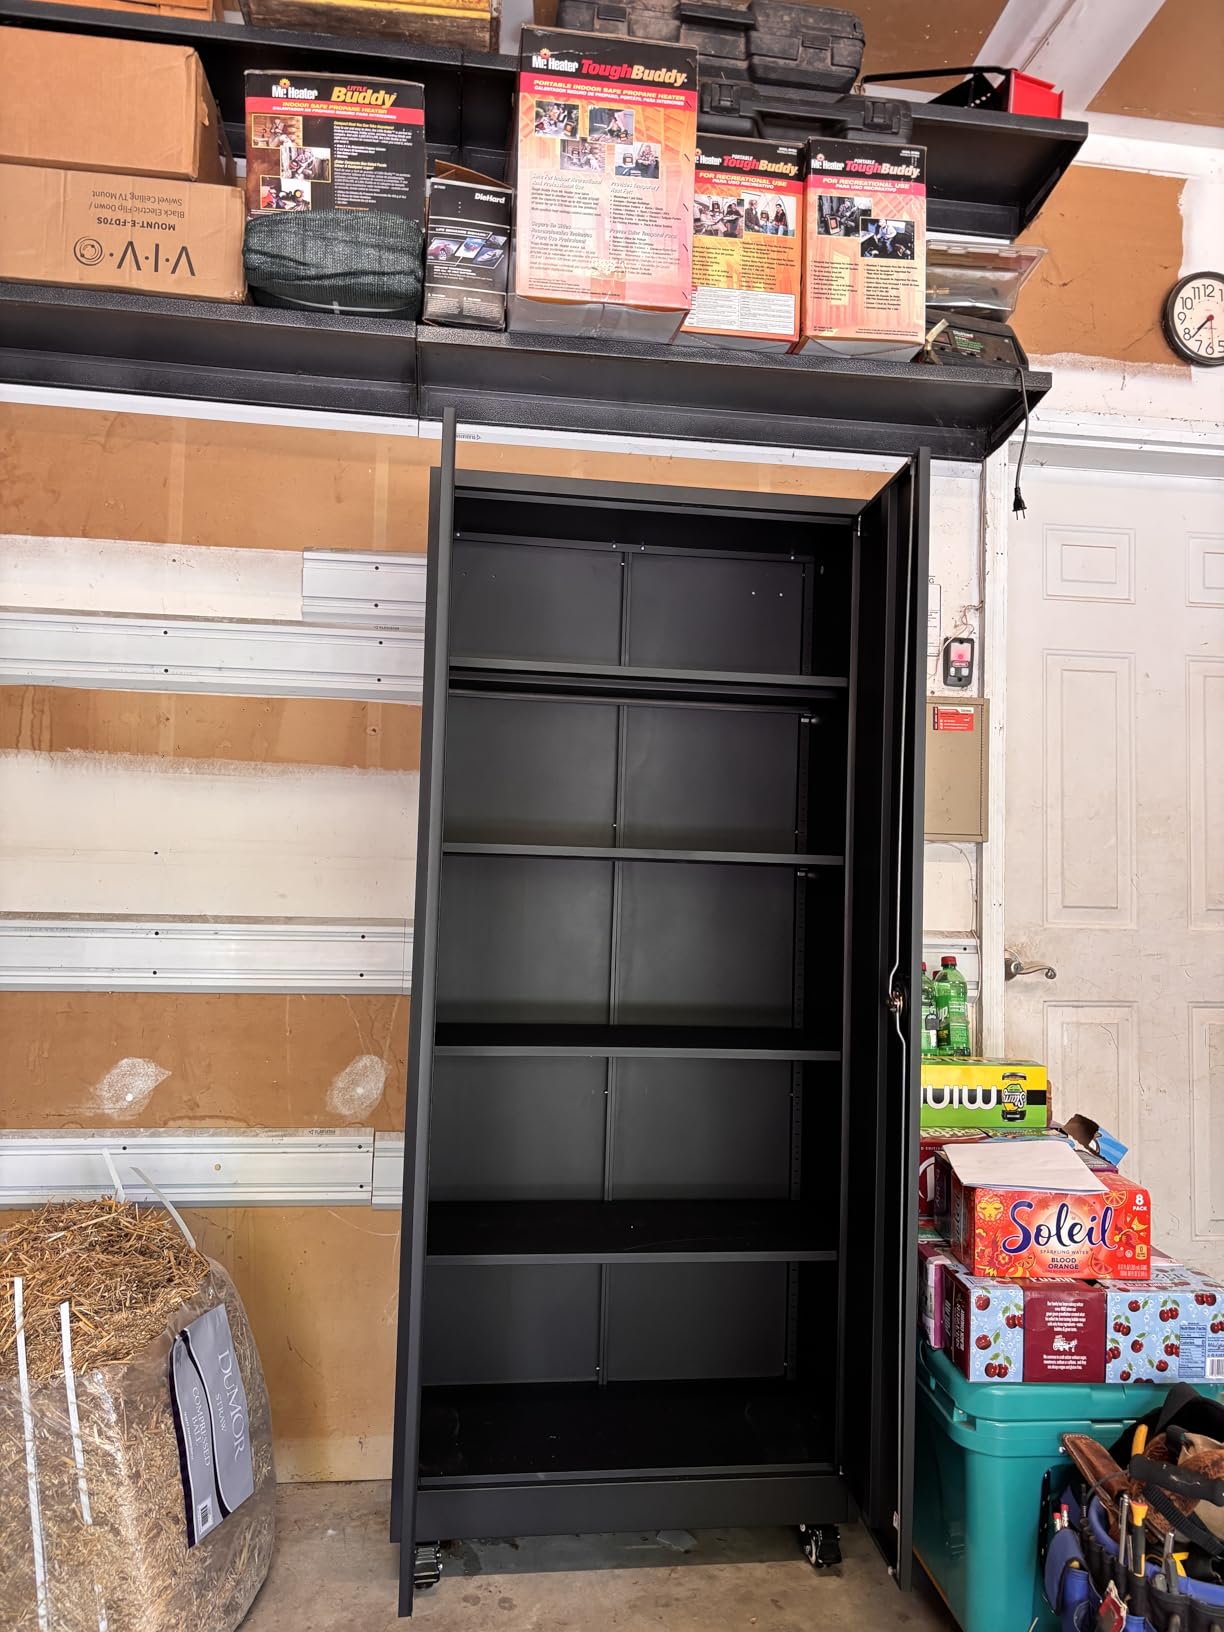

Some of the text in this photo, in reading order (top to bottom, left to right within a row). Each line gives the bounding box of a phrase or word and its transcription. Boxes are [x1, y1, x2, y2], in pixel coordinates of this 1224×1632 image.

[532, 56, 546, 68] Mr.
[548, 58, 578, 72] Heater
[272, 85, 318, 100] Mr. Heater
[534, 80, 572, 88] PORTABLE
[574, 84, 602, 92] INDOOR
[622, 90, 656, 98] PROPANE
[331, 86, 397, 109] Buddy
[700, 155, 722, 166] Heater
[823, 160, 844, 170] Heater
[716, 174, 771, 184] RECREATIONAL
[839, 179, 893, 188] RECREATIONAL
[92, 190, 183, 206] Swivel Ceiling TV Mount
[474, 192, 506, 204] DieHard
[94, 202, 116, 212] Down
[118, 204, 132, 214] Flip
[133, 206, 162, 217] Electric
[164, 210, 185, 218] Black
[1192, 286, 1201, 300] 11
[1202, 284, 1215, 298] 12
[1180, 296, 1193, 310] 10
[1178, 312, 1186, 325] 9
[1183, 328, 1192, 341] 8
[1195, 340, 1202, 352] 7
[1206, 342, 1214, 355] 6
[1136, 1194, 1144, 1206] 8
[1002, 1200, 1118, 1254] Soleil
[216, 1393, 227, 1432] STRAW
[192, 1386, 210, 1466] COMPRESSED
